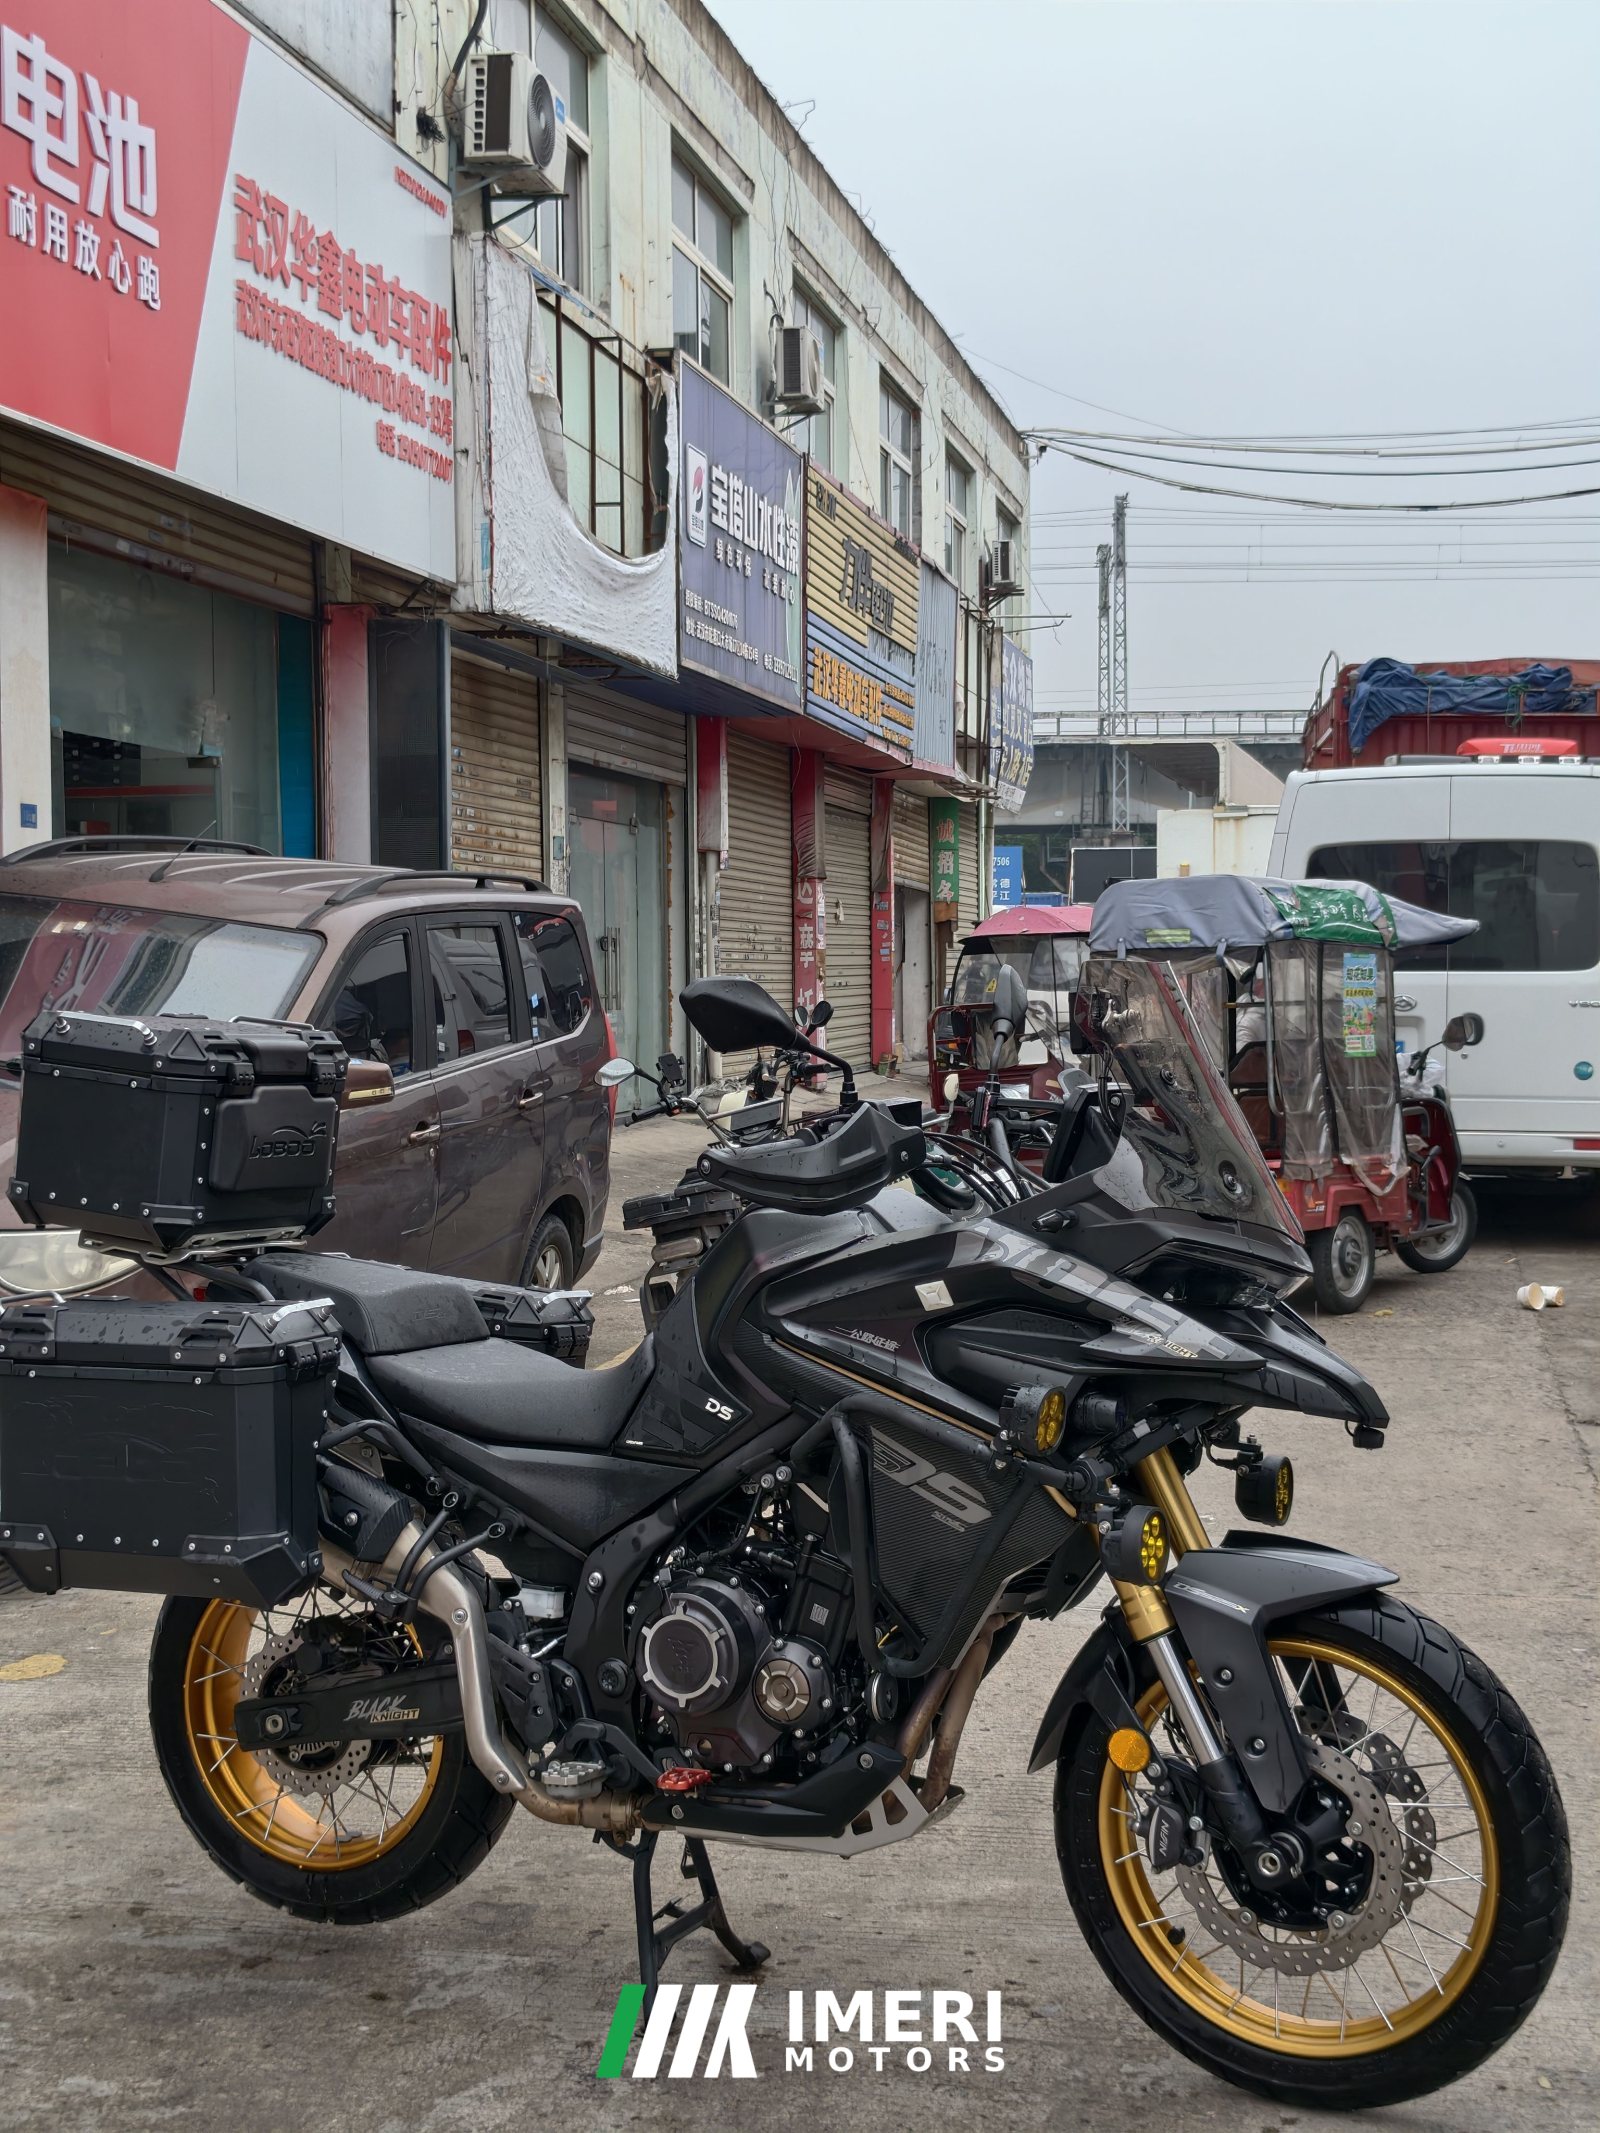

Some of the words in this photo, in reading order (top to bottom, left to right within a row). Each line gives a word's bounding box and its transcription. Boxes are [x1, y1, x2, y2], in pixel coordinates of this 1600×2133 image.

[1, 23, 160, 249] 电池
[6, 184, 162, 312] 耐用放心跑
[234, 173, 453, 387] 武汉华鑫电动车配件
[710, 465, 799, 577] 宝塔山水性漆
[715, 537, 752, 577] 绿色环保
[704, 1397, 735, 1421] DS
[870, 1425, 992, 1524] DS
[343, 1694, 408, 1722] BLACK
[370, 1708, 420, 1723] KNIGHT
